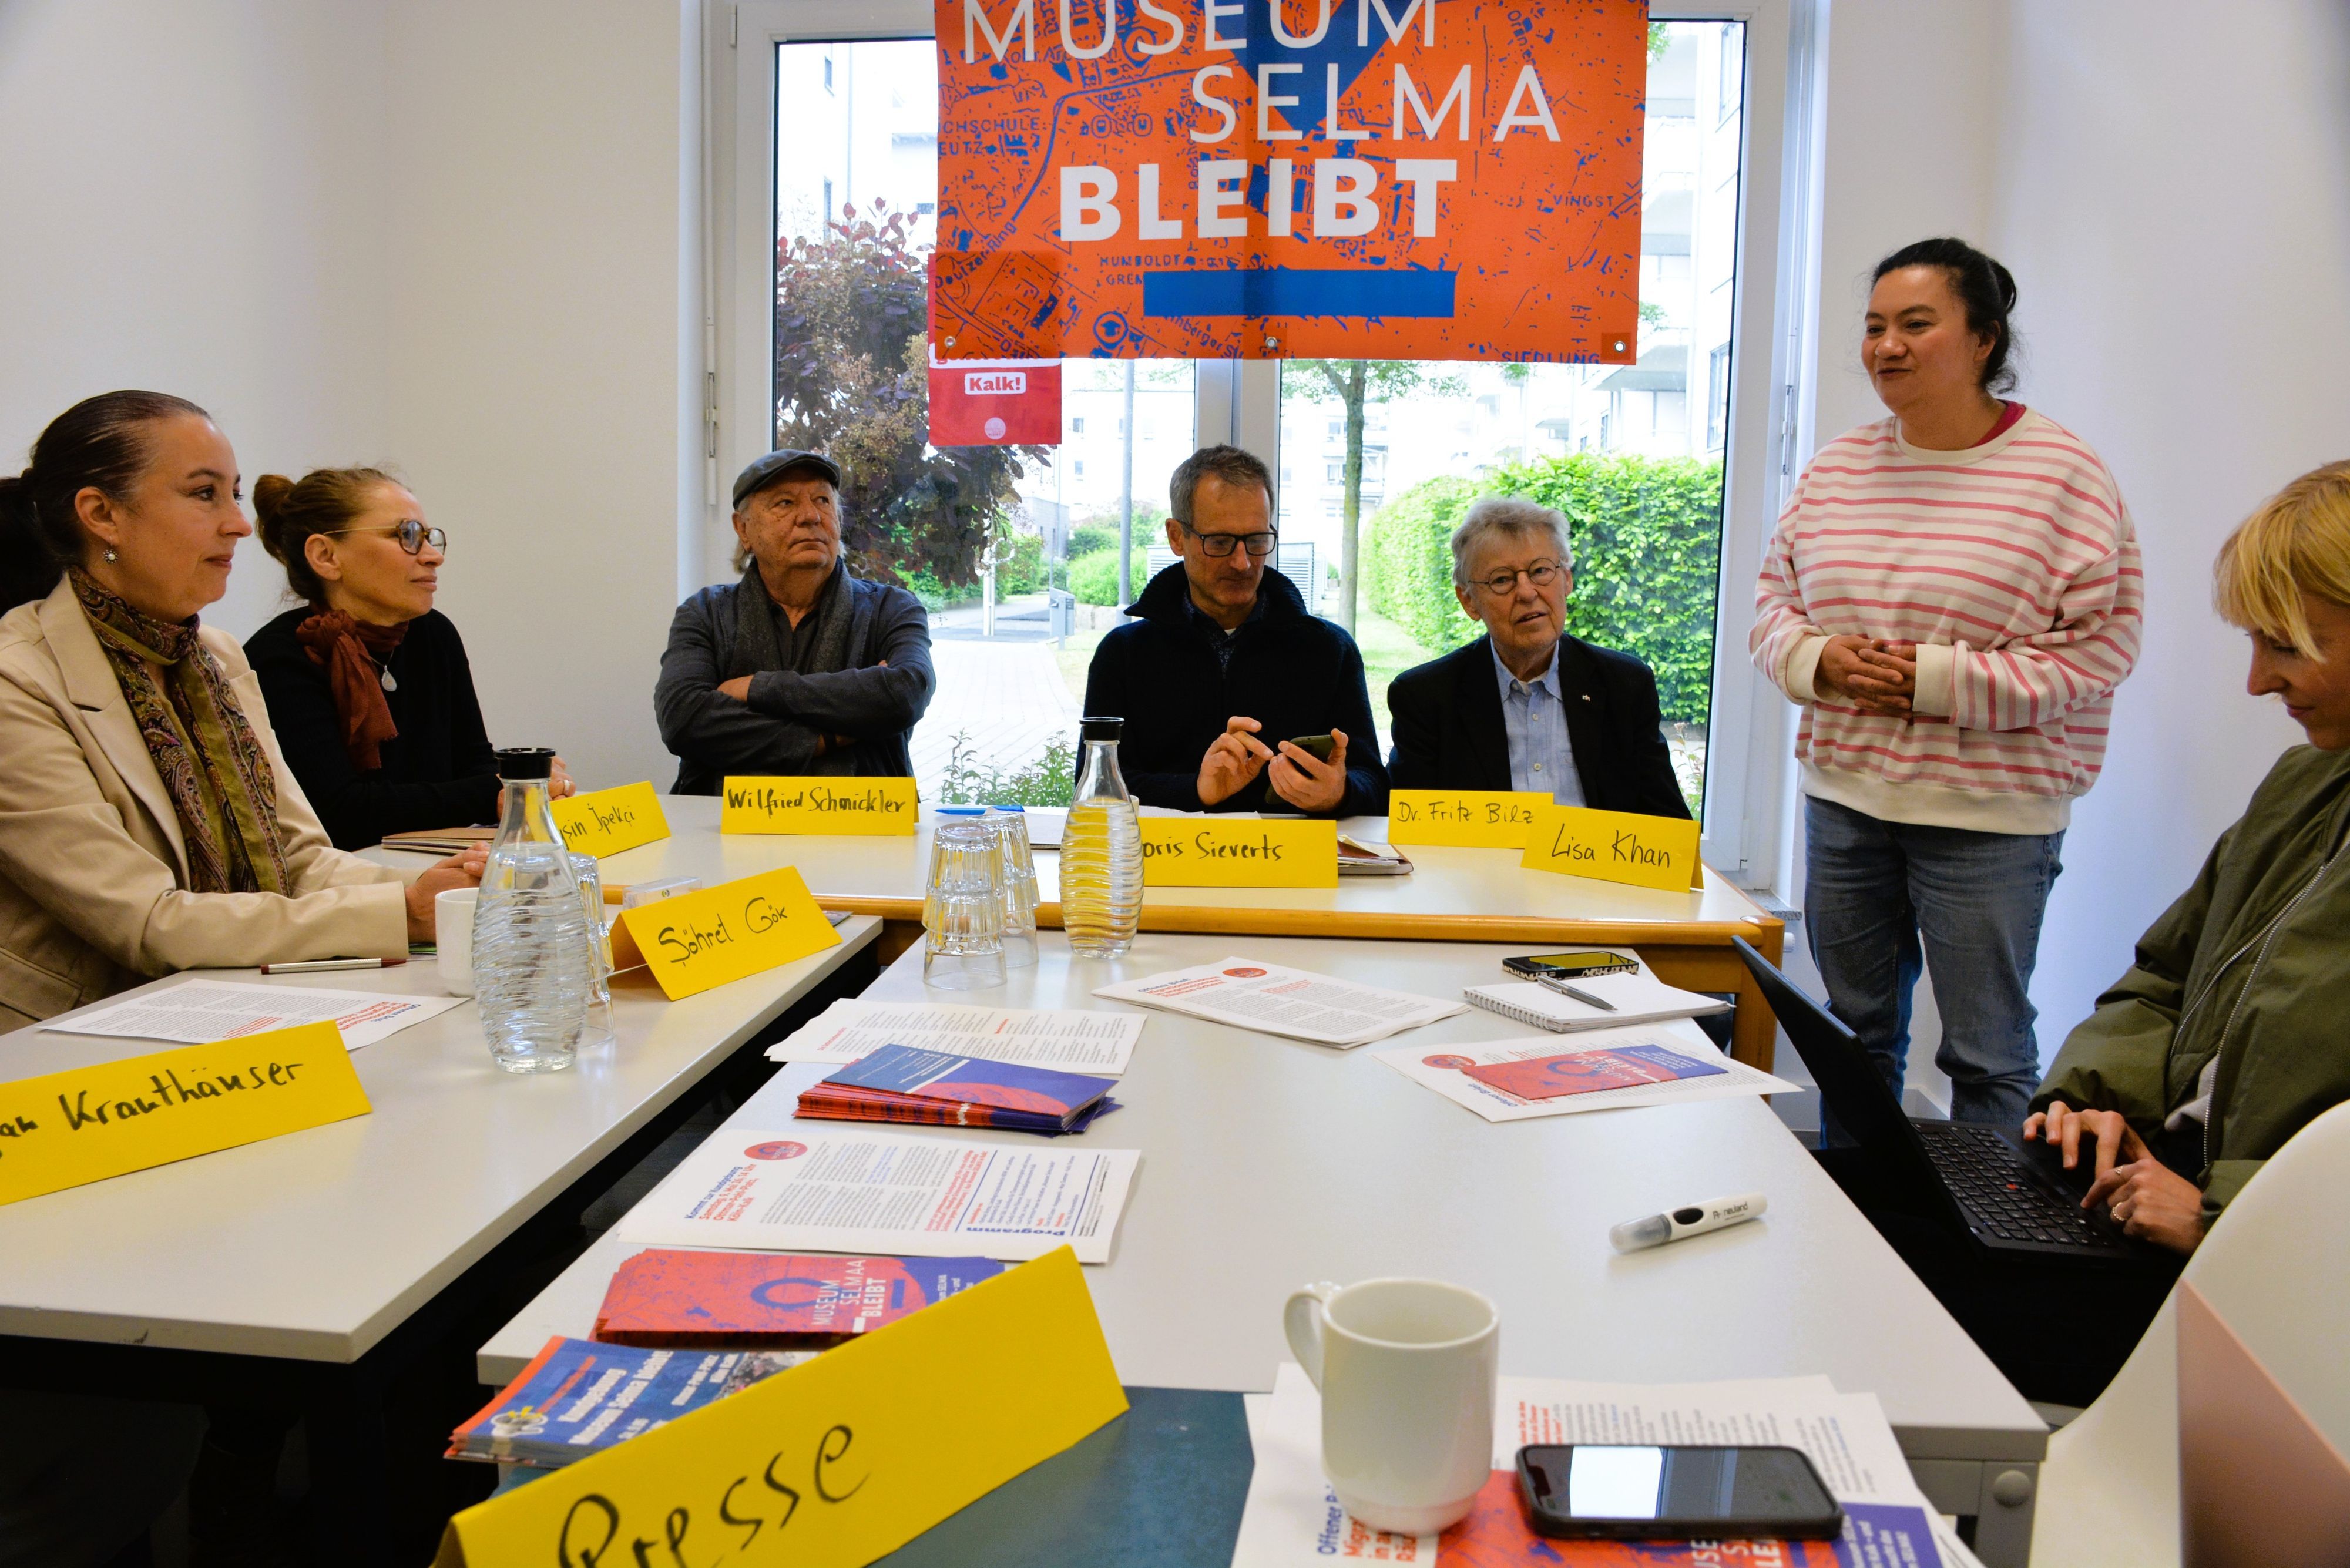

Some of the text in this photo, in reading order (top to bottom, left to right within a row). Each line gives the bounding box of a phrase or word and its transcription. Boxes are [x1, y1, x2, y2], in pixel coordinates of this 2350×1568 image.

[965, 0, 1435, 63] MUSEUM
[1190, 63, 1561, 143] SELMA
[1060, 158, 1457, 242] BLEIBT
[1553, 194, 1616, 208] VINGST
[969, 376, 1021, 391] Kalk!
[728, 787, 905, 819] Wilfried Schmickler
[1396, 800, 1534, 824] Dr. Fritz Bilz
[1143, 832, 1283, 861] oris Sieverts
[1552, 823, 1670, 868] Lisa Khan
[745, 897, 788, 934] Gök
[1596, 1055, 1647, 1075] BLEIBT
[58, 1061, 304, 1131] Krauthäuser
[1723, 1201, 1748, 1217] neuland
[966, 1226, 1077, 1237] Programm
[811, 1279, 840, 1325] MUSEUM
[861, 1277, 887, 1317] BLEIBT
[559, 1424, 871, 1568] Presse
[1317, 1506, 1342, 1555] Offener
